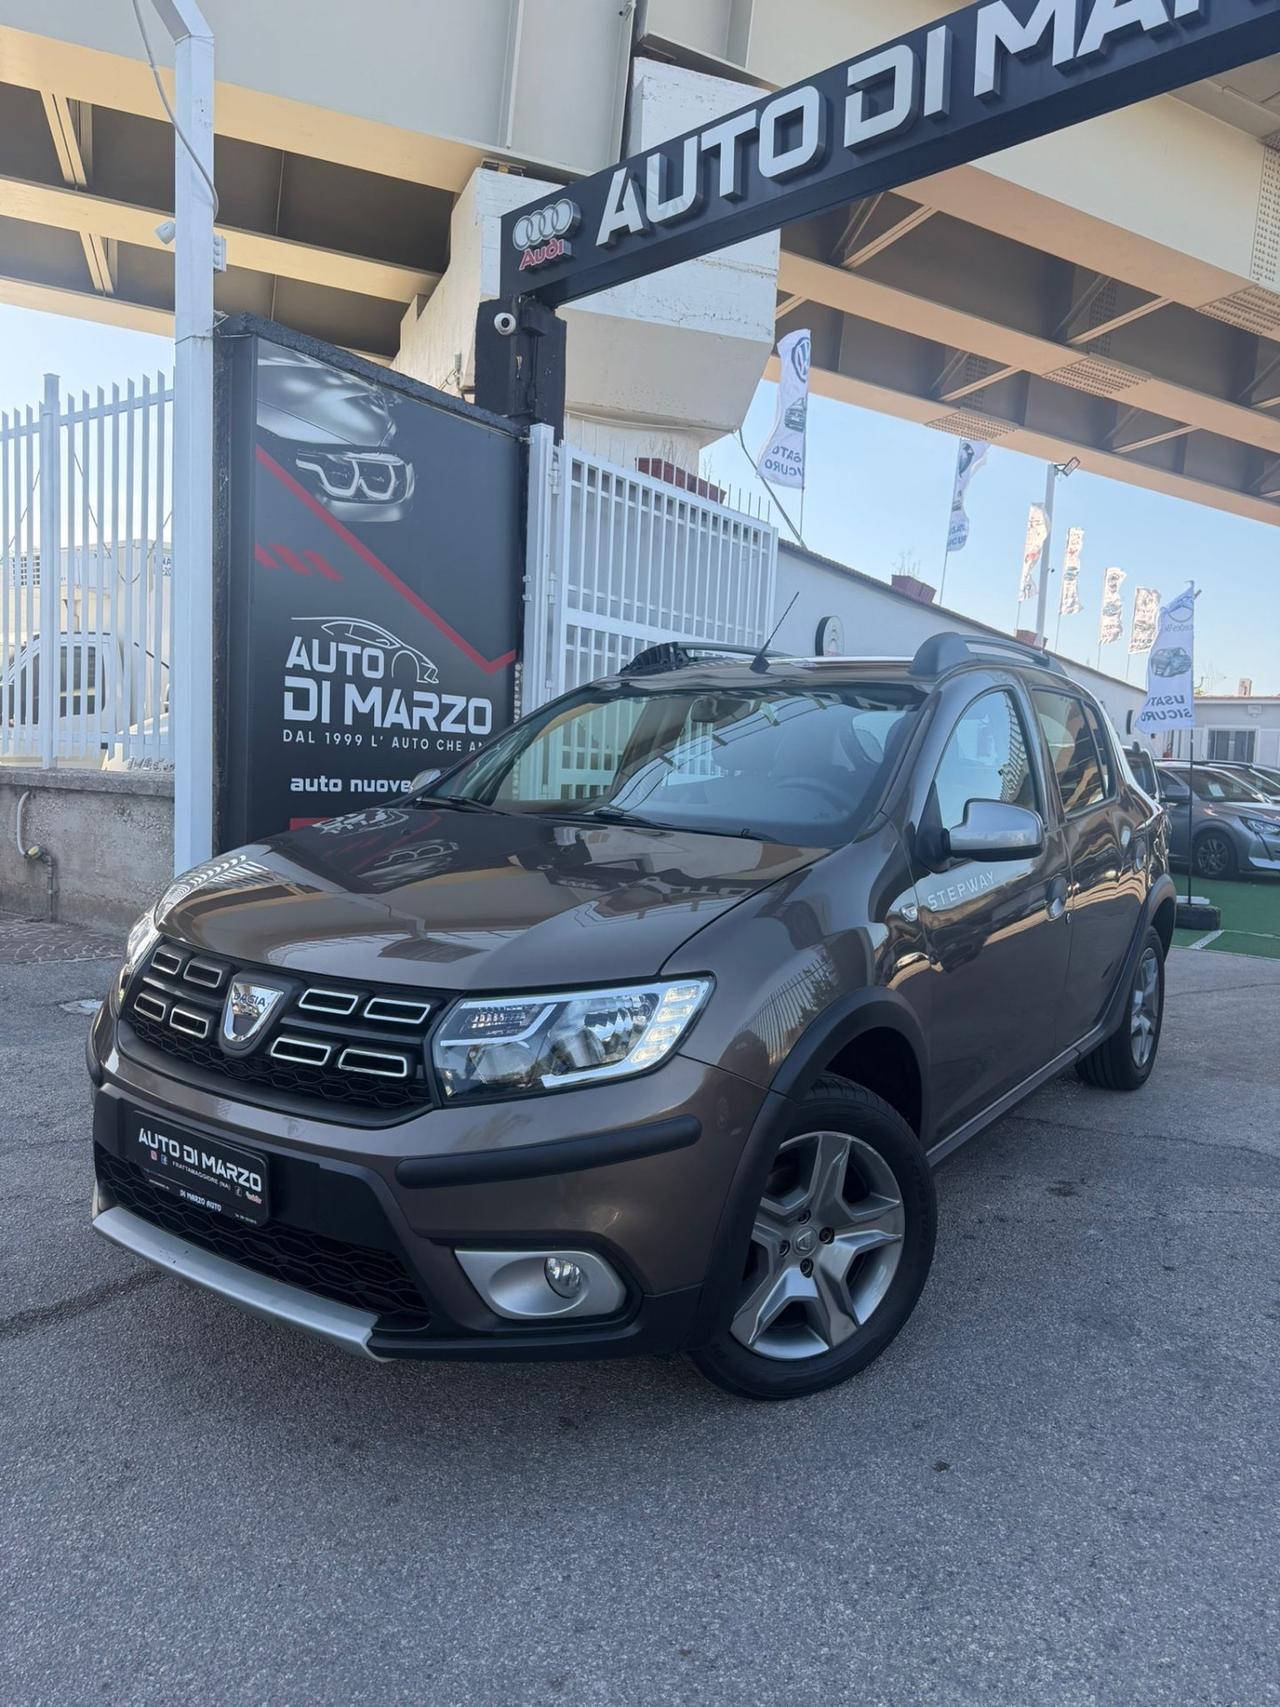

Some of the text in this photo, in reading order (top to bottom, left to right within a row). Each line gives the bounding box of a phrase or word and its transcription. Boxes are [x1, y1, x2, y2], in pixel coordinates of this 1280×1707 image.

[596, 0, 1200, 246] AUTO DI MA
[519, 238, 565, 271] Audi
[285, 635, 384, 679] AUTO
[283, 676, 493, 735] DI MARZO
[283, 729, 316, 744] DAL
[325, 731, 363, 747] 1999
[391, 736, 429, 750] AUTO
[436, 738, 462, 752] CHE
[290, 775, 411, 793] auto nuove
[926, 870, 996, 911] STEPWAY
[139, 1128, 180, 1158] AUTO
[183, 1144, 199, 1166] DI
[201, 1152, 262, 1192] MARZO
